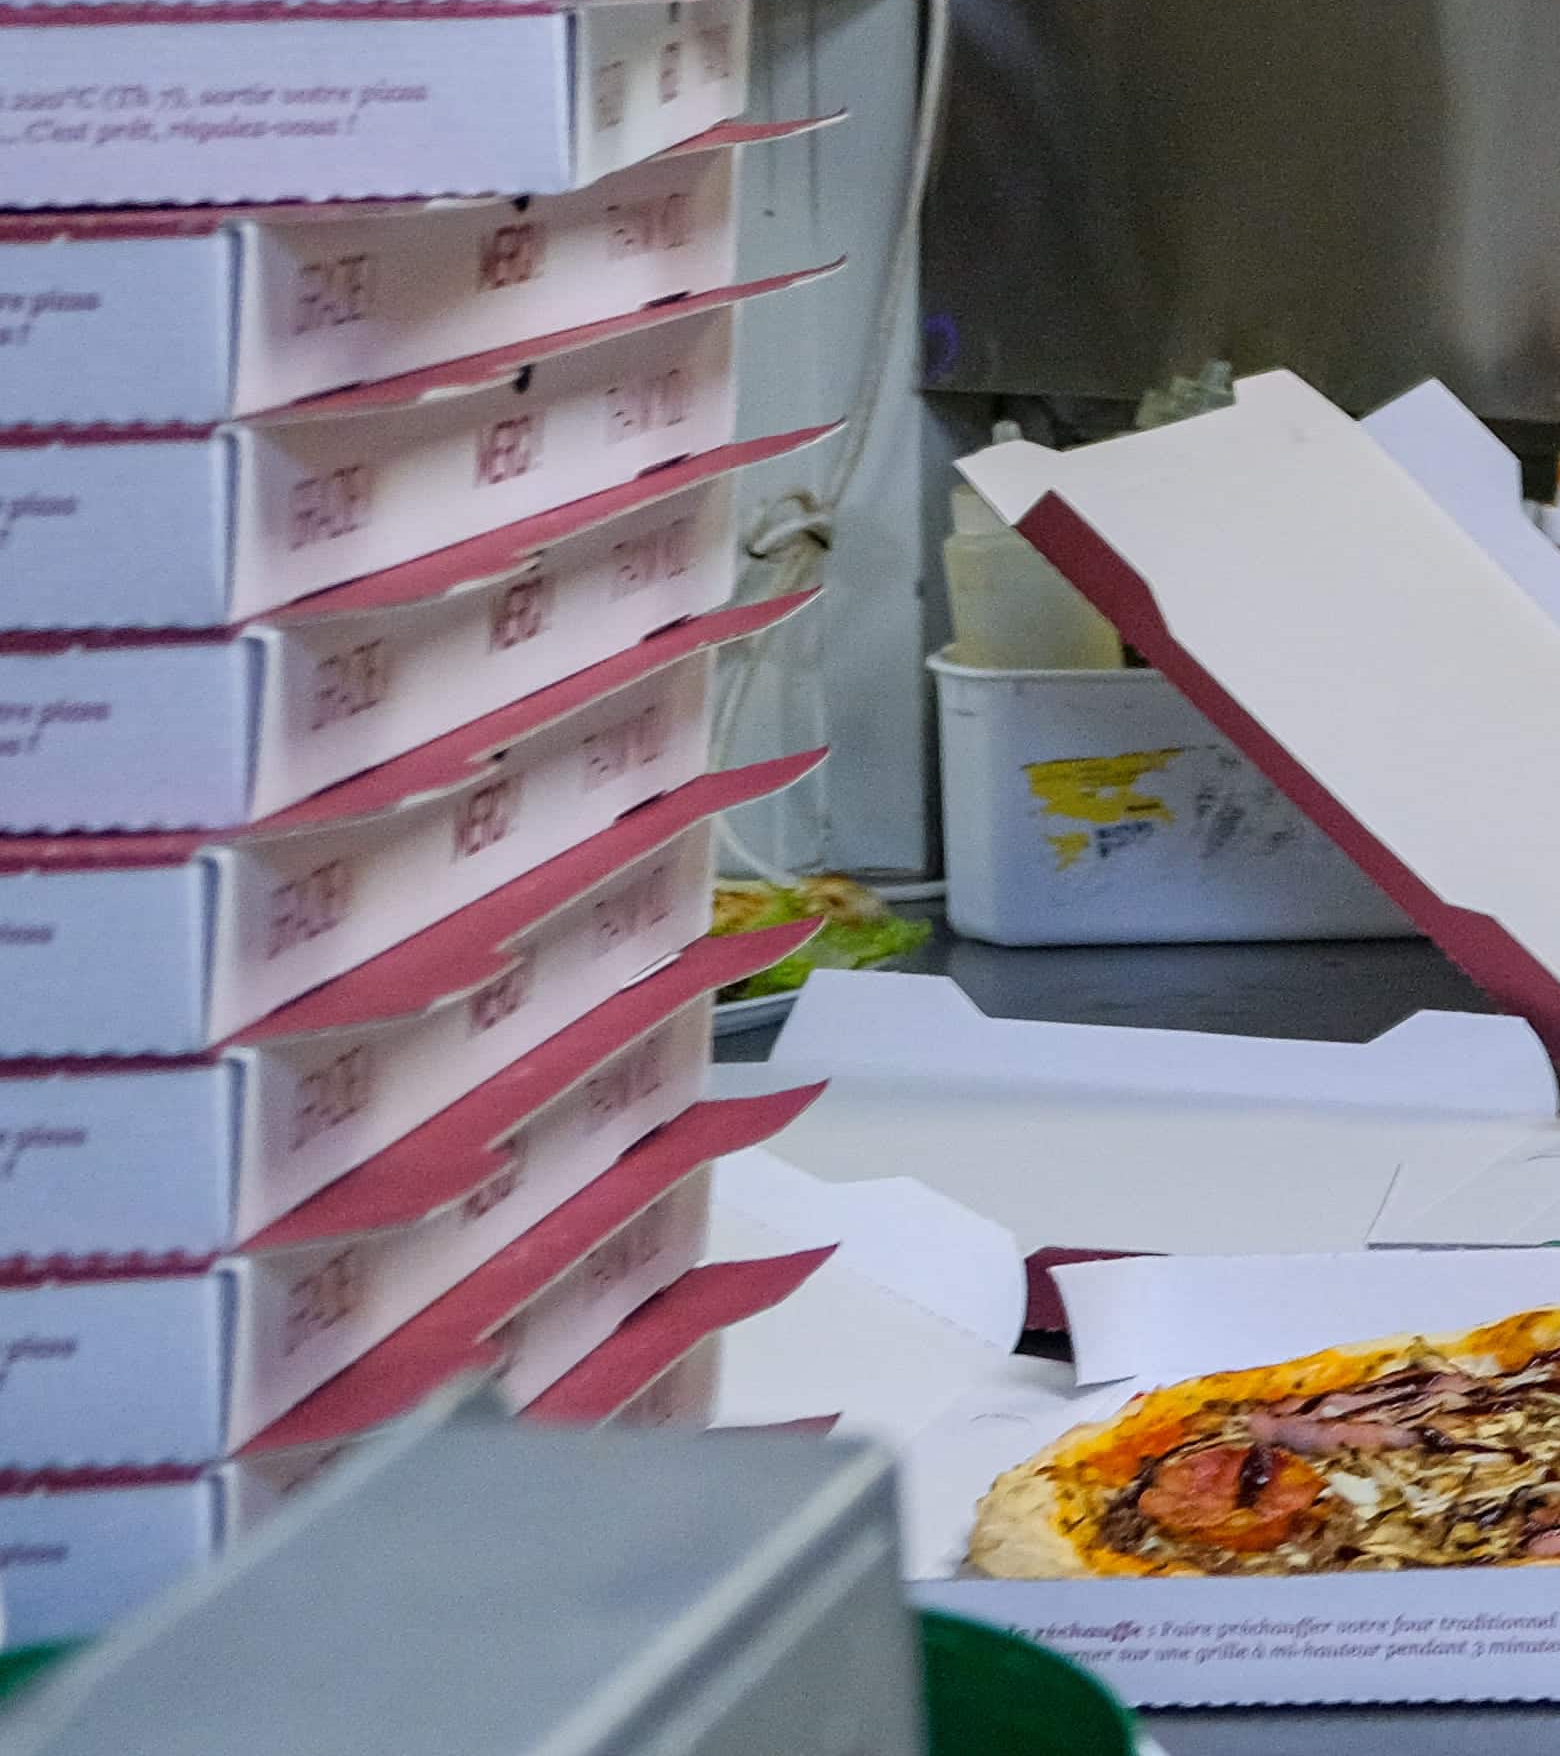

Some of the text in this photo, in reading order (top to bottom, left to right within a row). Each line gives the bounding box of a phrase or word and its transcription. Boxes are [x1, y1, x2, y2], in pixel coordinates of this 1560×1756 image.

[198, 83, 275, 107] sortir
[280, 86, 353, 106] votre
[357, 79, 430, 110] pizza
[30, 286, 103, 318] pizza
[8, 492, 80, 521] pizza
[36, 695, 112, 729] pizza
[13, 1120, 89, 1151] pizza
[3, 1332, 79, 1364] pizza
[1033, 1620, 1141, 1642] réchauffe
[1213, 1615, 1331, 1640] préchauffer
[1334, 1619, 1388, 1635] votre
[1389, 1612, 1434, 1636] four
[1437, 1610, 1558, 1632] traditionnel
[1117, 1648, 1150, 1662] sur
[1151, 1646, 1190, 1661] une
[1193, 1641, 1249, 1664] grille
[1269, 1640, 1379, 1659] mi-hauteur
[1382, 1638, 1468, 1661] pendant
